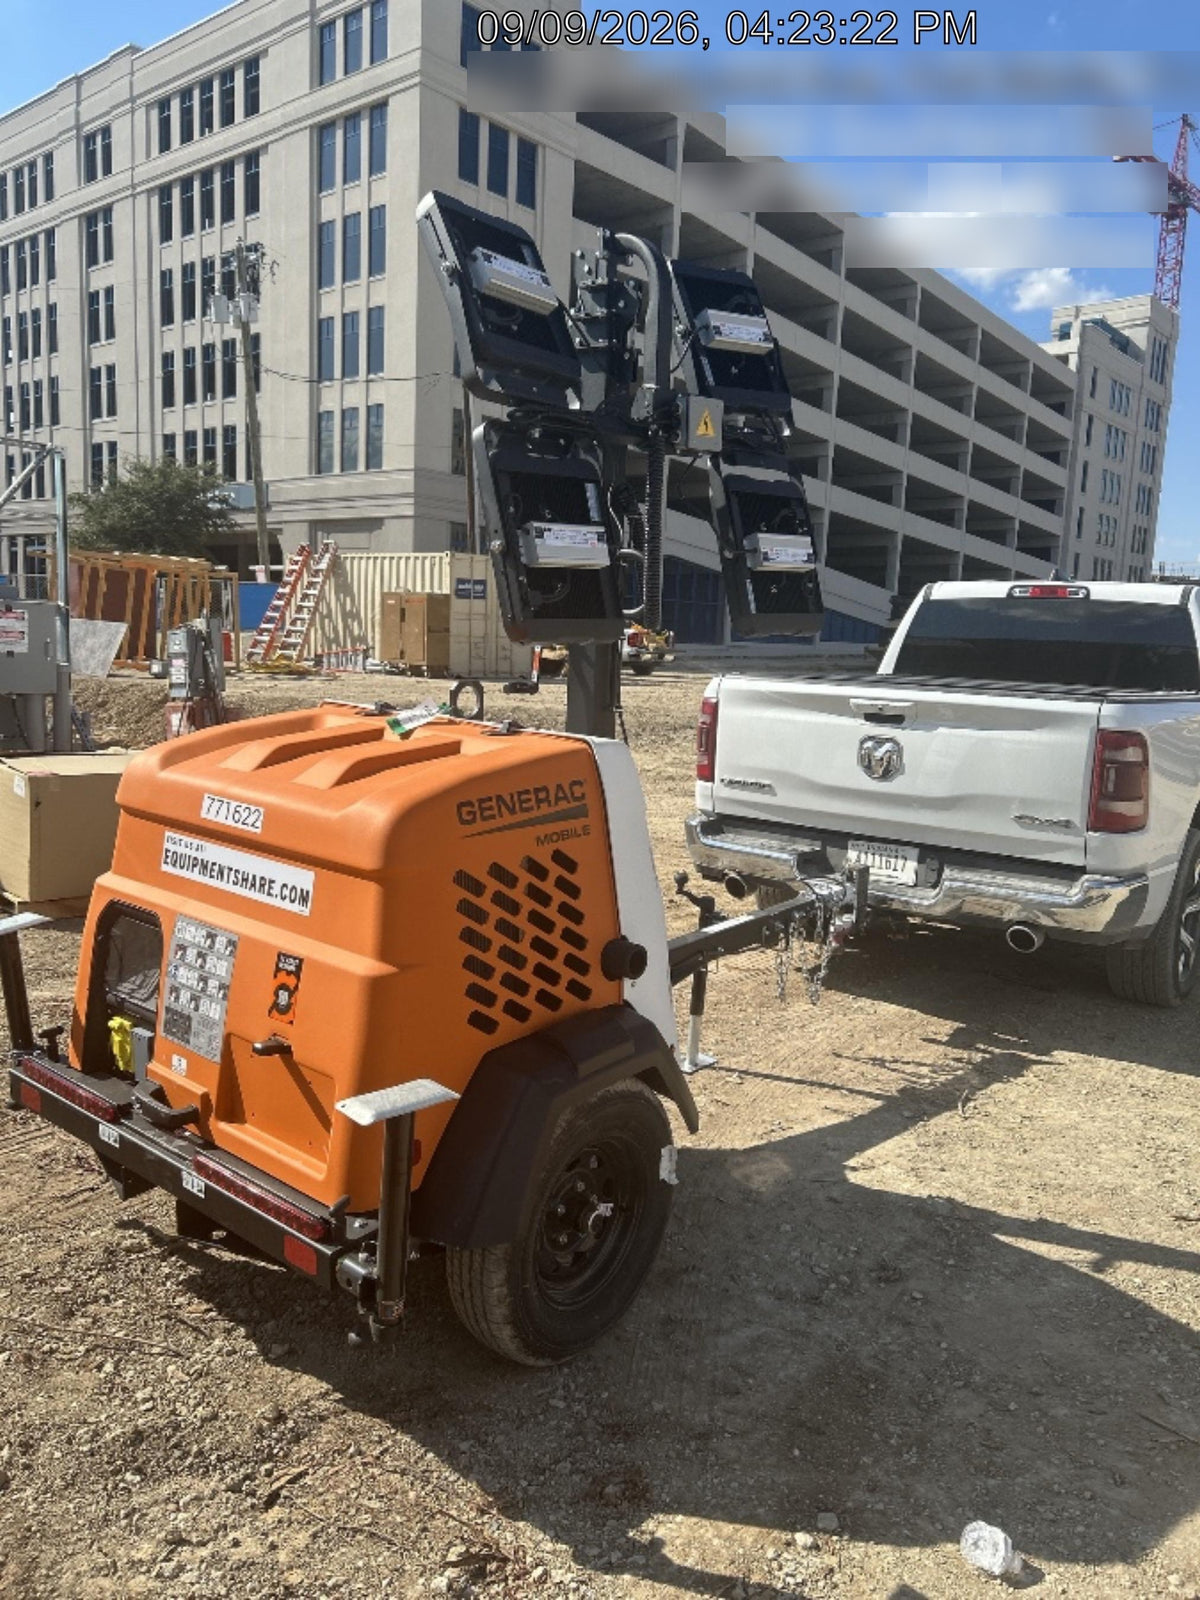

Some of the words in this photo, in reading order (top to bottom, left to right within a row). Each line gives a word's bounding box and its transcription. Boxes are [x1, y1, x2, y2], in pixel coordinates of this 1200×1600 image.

[205, 795, 263, 830] 771622
[456, 779, 586, 826] GENERAC
[535, 824, 592, 847] MOBILE
[162, 847, 310, 909] EQUIPMENTSHARE.COM
